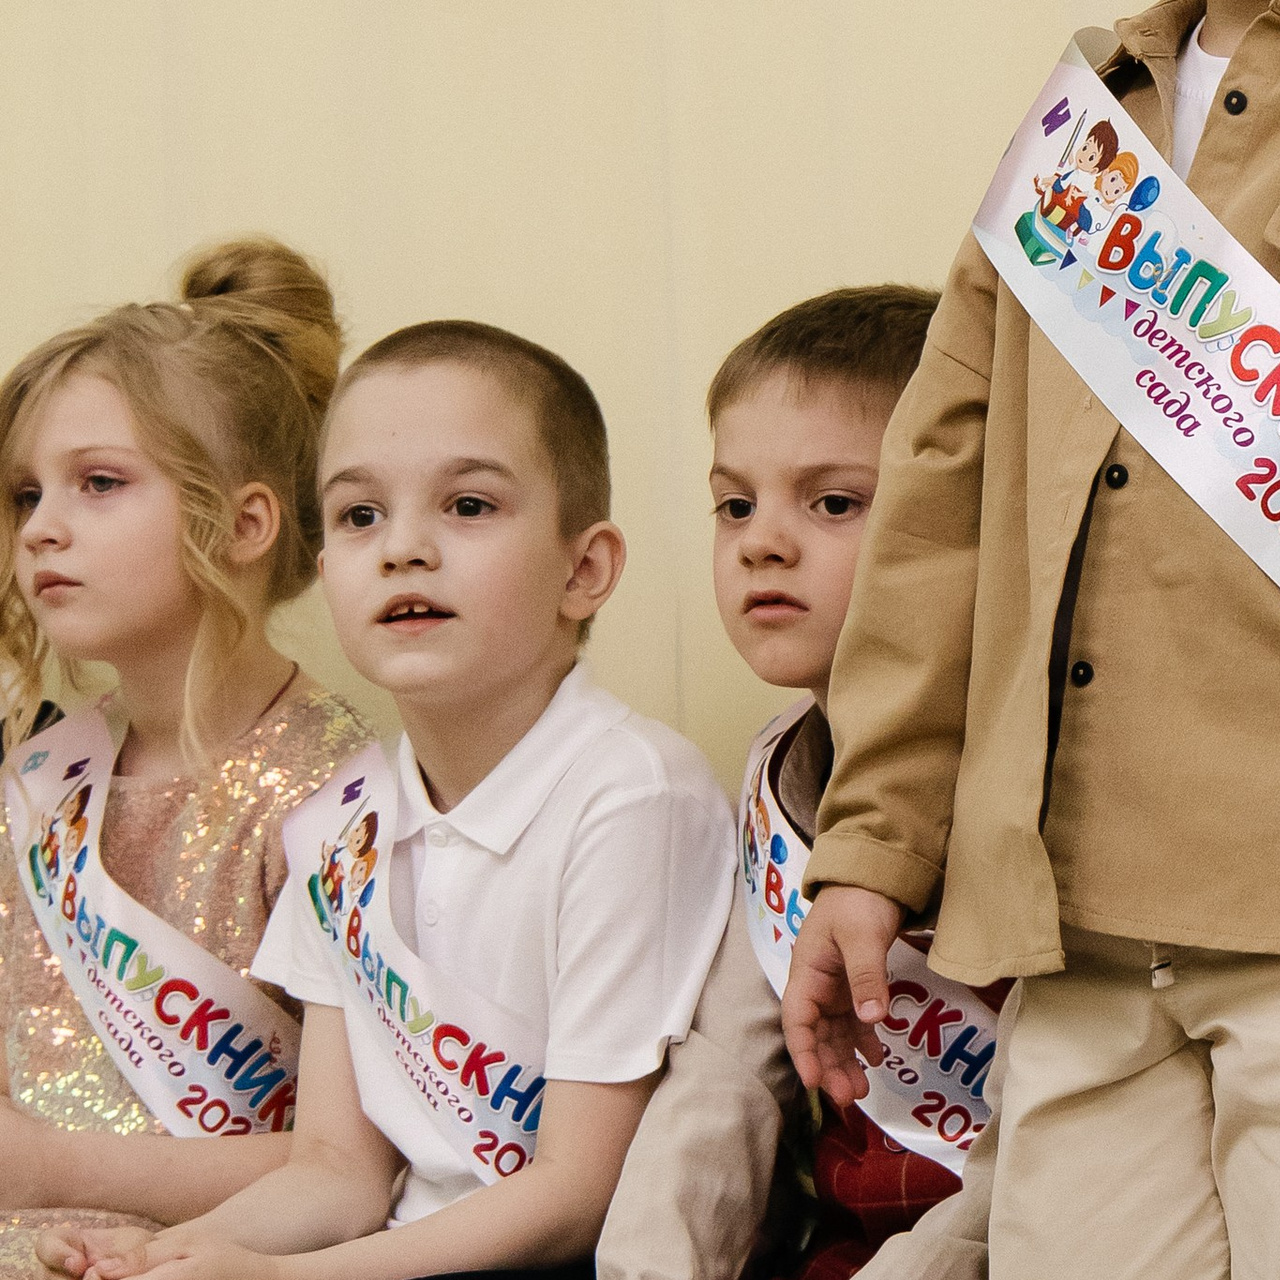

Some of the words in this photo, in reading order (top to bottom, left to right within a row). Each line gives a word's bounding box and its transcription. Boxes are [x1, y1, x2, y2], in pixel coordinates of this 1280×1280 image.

[1132, 309, 1255, 447] детского
[1135, 368, 1202, 438] сада
[87, 960, 186, 1077] детского
[98, 1010, 144, 1069] сада
[345, 905, 547, 1132] ВЫПУСКН
[377, 999, 474, 1123] детского
[395, 1049, 438, 1111] сада
[176, 1083, 253, 1136] 202
[911, 1091, 987, 1151] 20
[472, 1130, 534, 1178] 20
